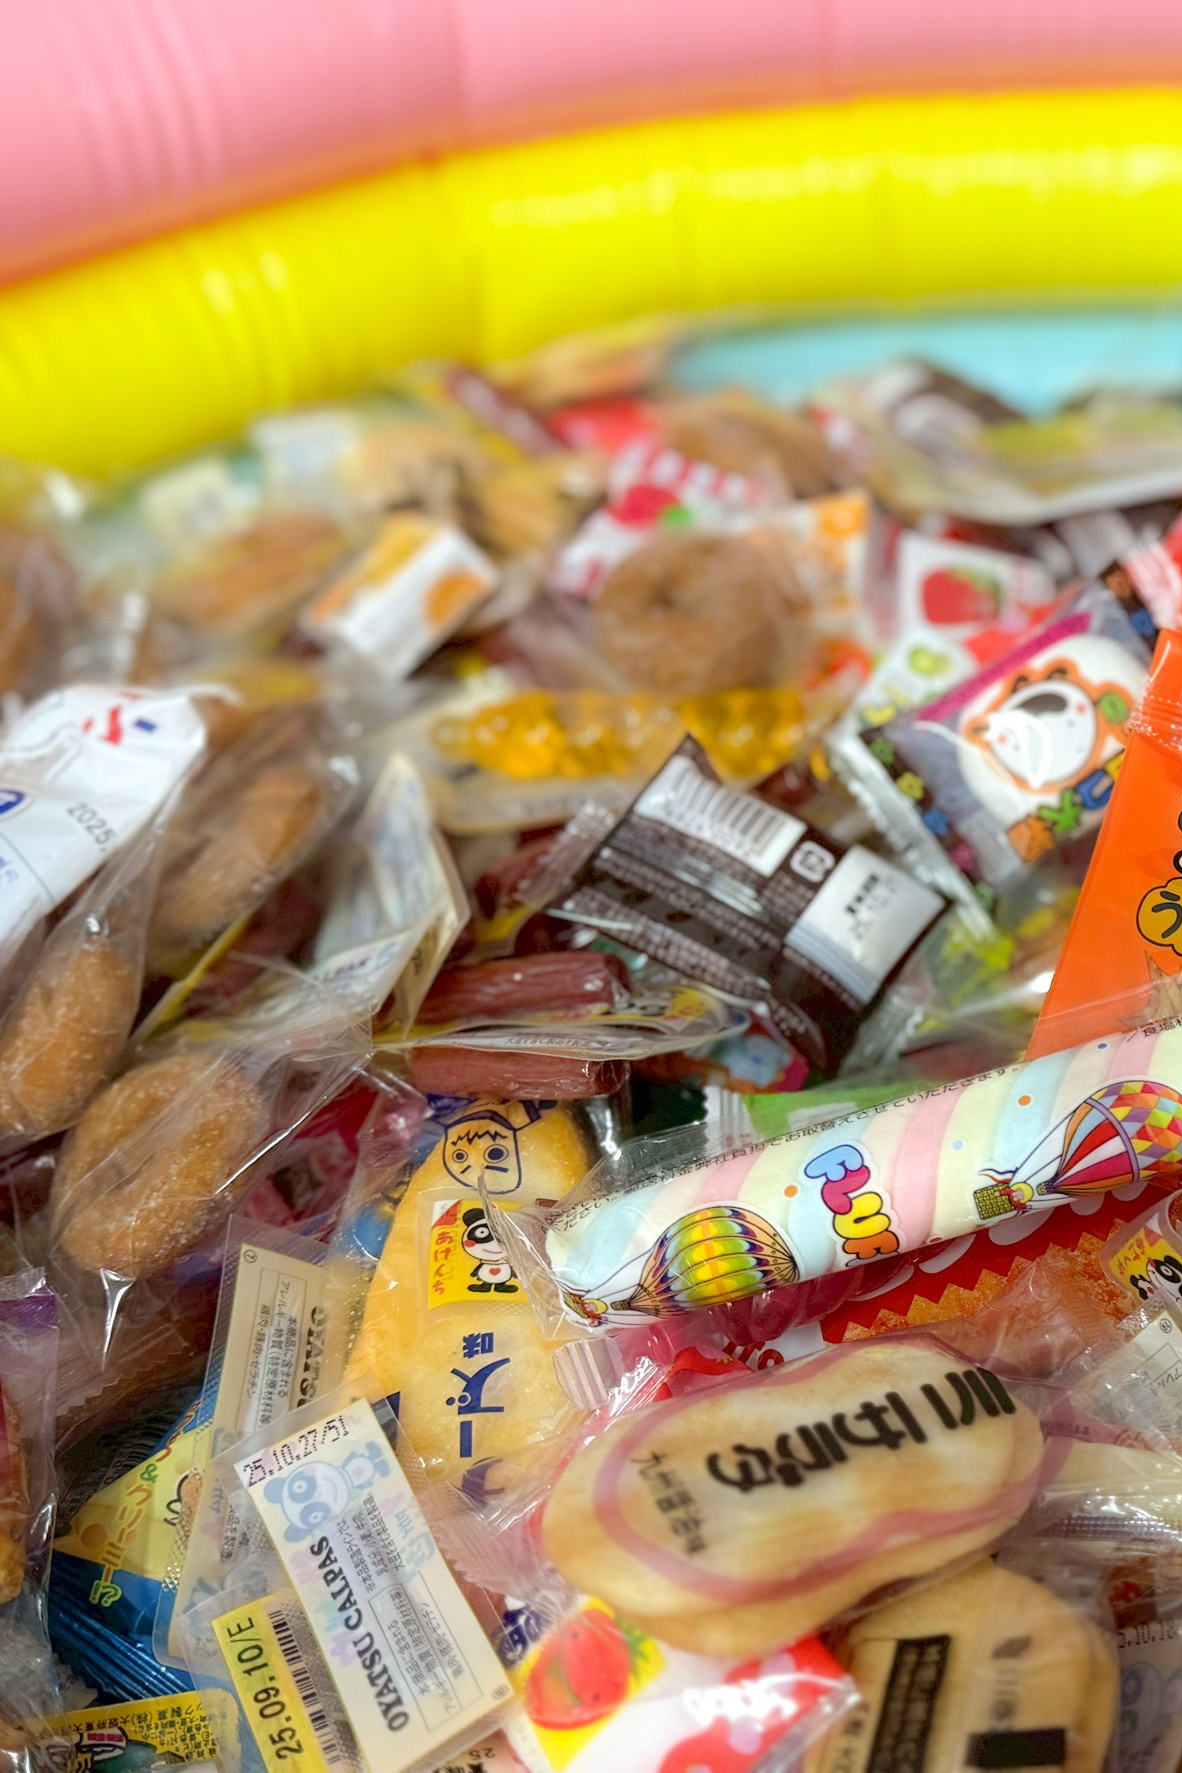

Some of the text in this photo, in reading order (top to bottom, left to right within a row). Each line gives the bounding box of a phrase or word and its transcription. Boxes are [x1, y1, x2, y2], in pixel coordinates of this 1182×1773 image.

[223, 1615, 305, 1761] 25.09.10/E
[309, 1534, 411, 1733] OYATSU CALPAS
